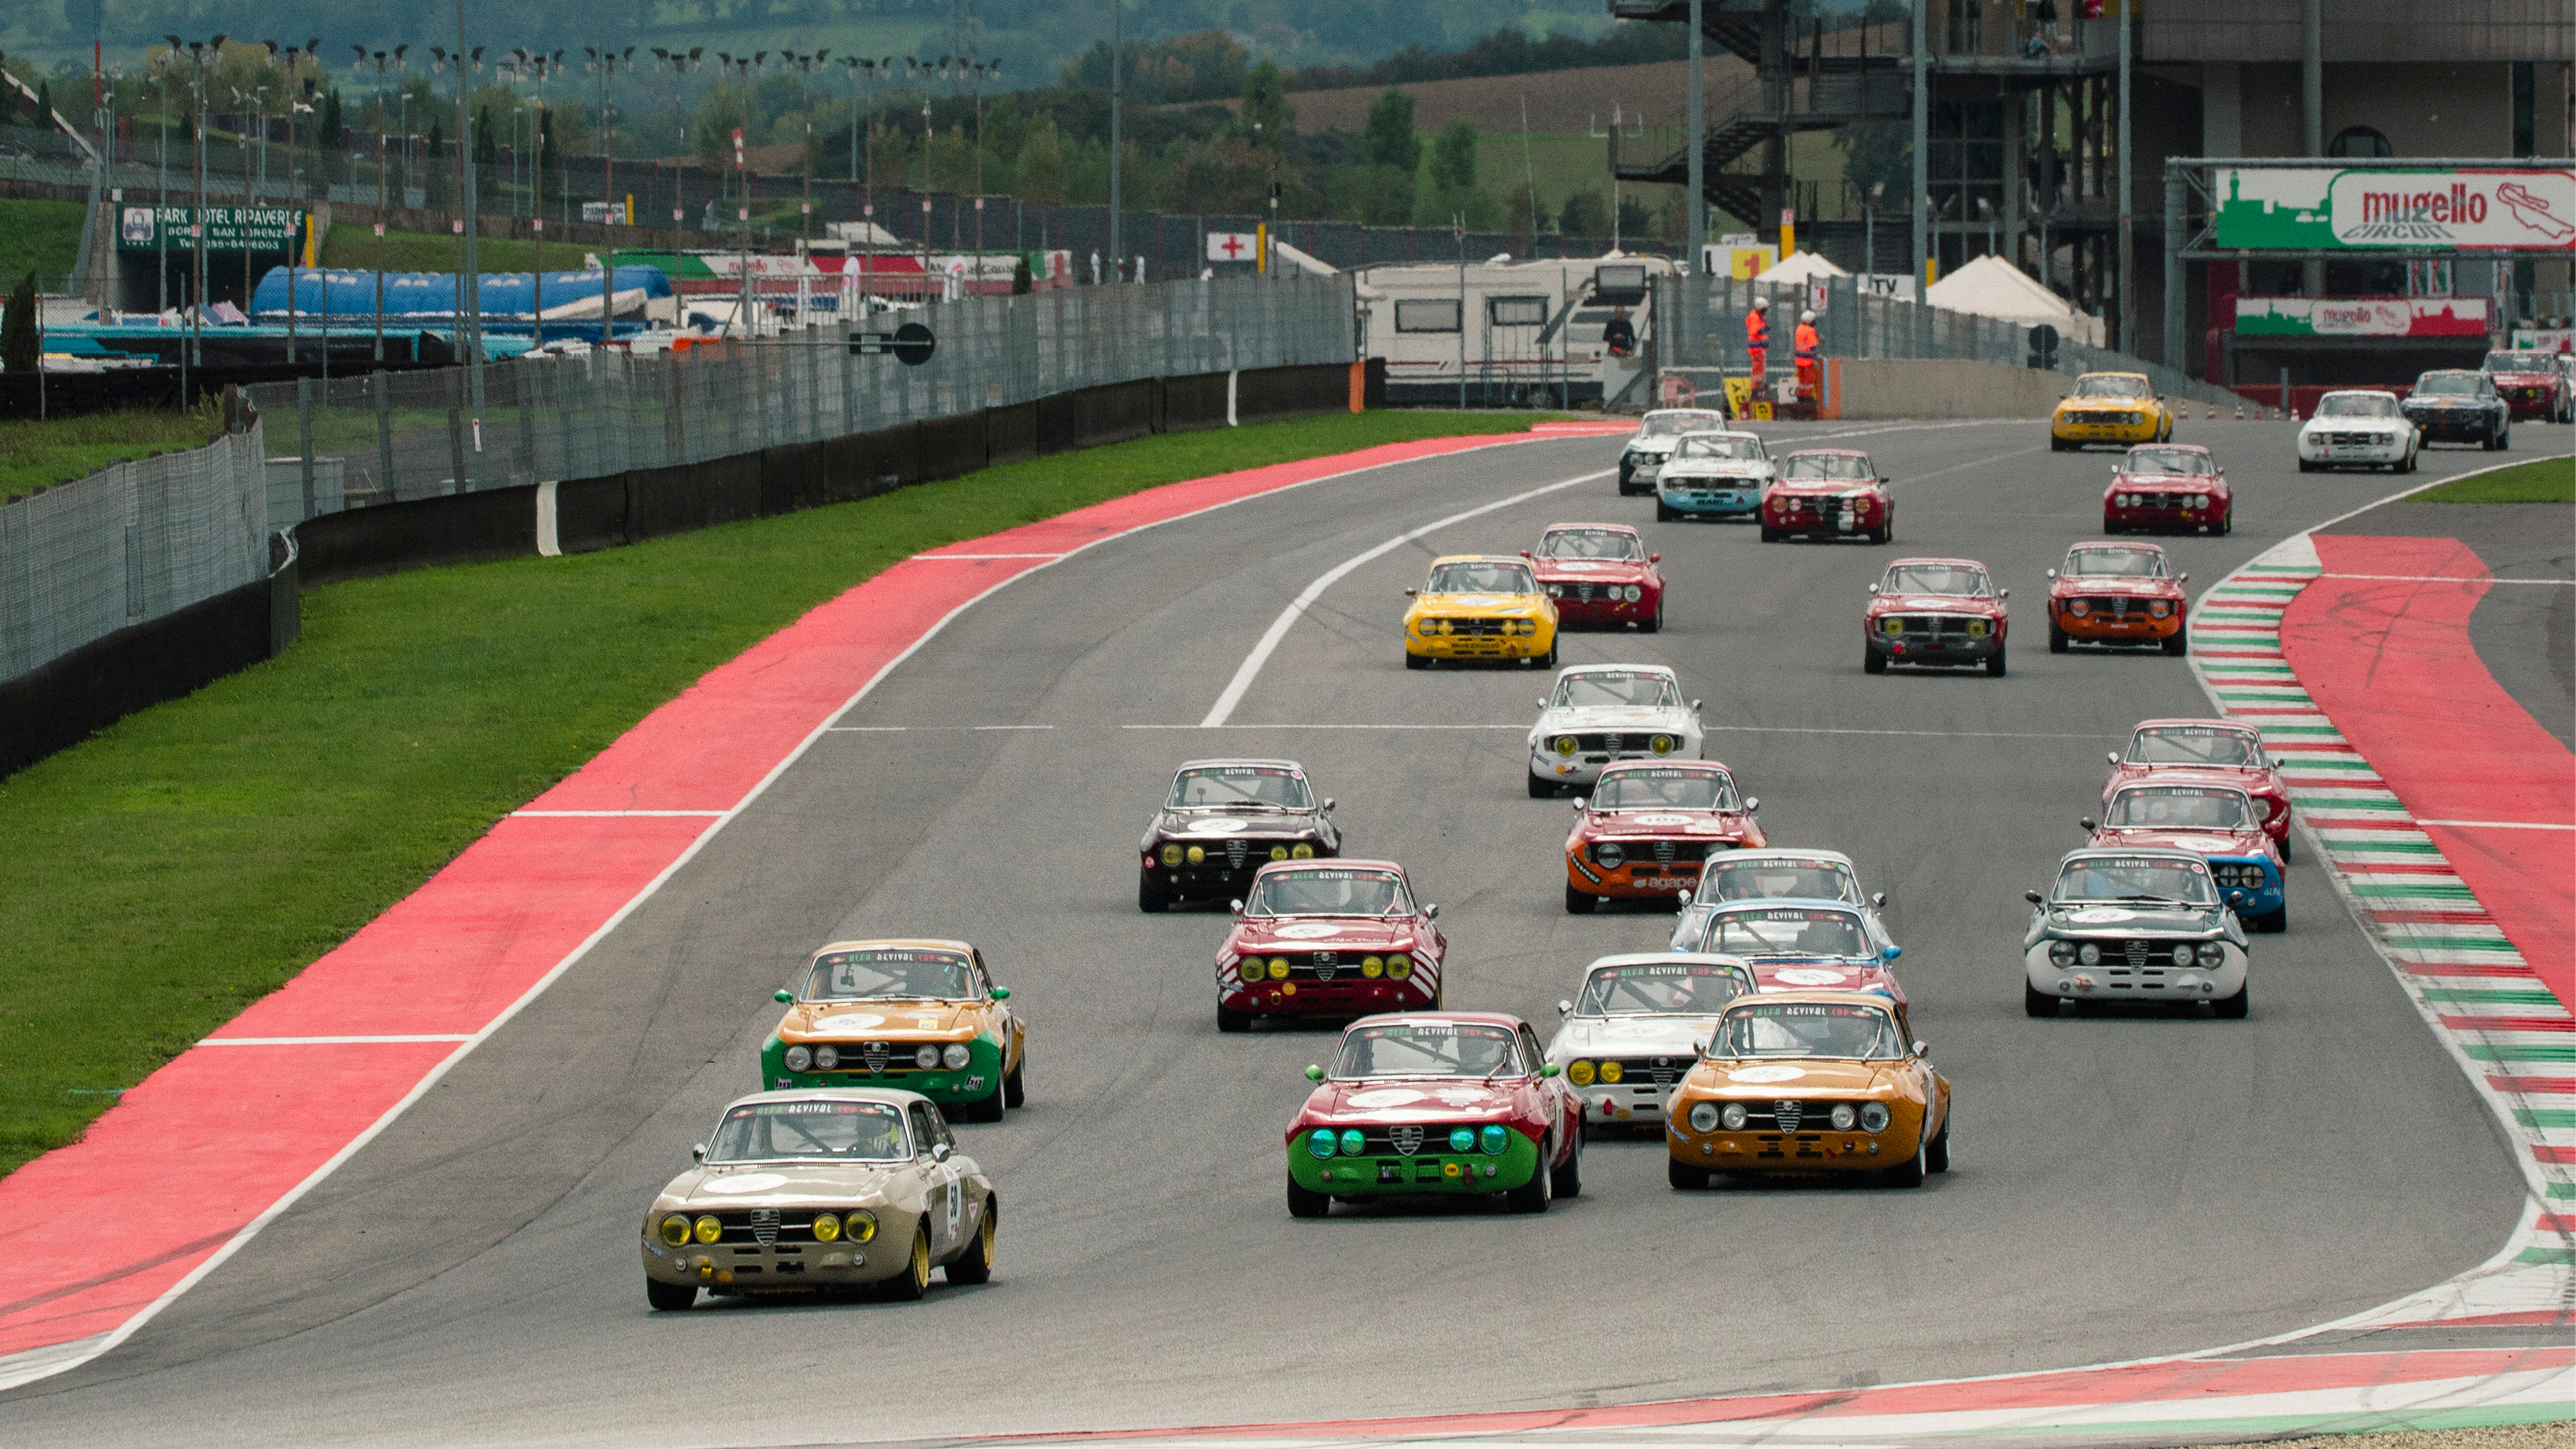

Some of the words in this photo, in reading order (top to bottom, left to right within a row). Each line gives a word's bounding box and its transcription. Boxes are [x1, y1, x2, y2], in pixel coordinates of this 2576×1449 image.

[2363, 183, 2488, 224] mugello
[156, 207, 188, 224] PARK
[2341, 223, 2456, 240] CIRCUIT
[1874, 278, 1897, 295] TV
[1647, 877, 1698, 891] agape
[1767, 911, 1806, 921] REVIVAL
[876, 952, 914, 962] REVIVAL
[1649, 966, 1688, 977] REVIVAL
[1786, 1006, 1826, 1016] REVIVAL
[1417, 1027, 1458, 1037] REVIVAL
[788, 1103, 832, 1115] REVIVAL
